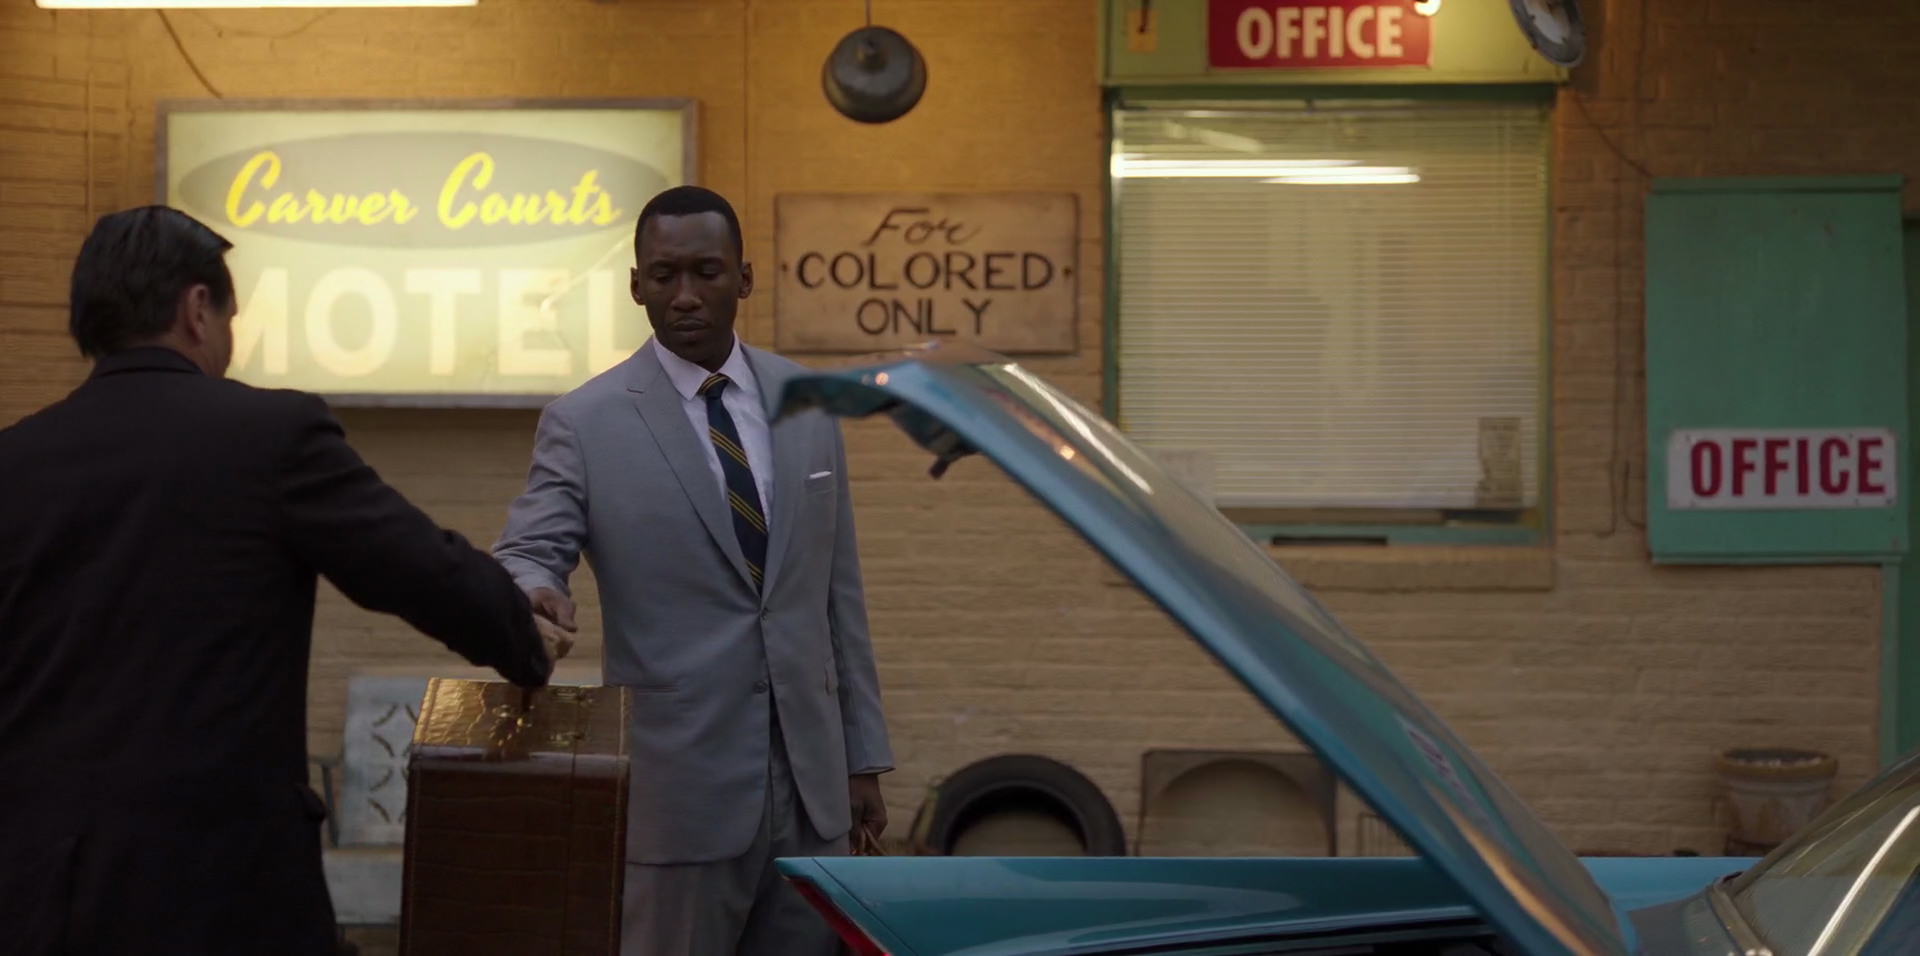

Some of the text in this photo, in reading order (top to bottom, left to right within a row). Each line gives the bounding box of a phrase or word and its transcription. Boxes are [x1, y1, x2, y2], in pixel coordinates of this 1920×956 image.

[1236, 6, 1404, 59] OFFICE
[226, 151, 621, 229] Carver Courts
[862, 207, 982, 246] For
[797, 251, 1053, 290] COLORED
[856, 298, 991, 336] ONLY
[1690, 437, 1885, 497] OFFICE
